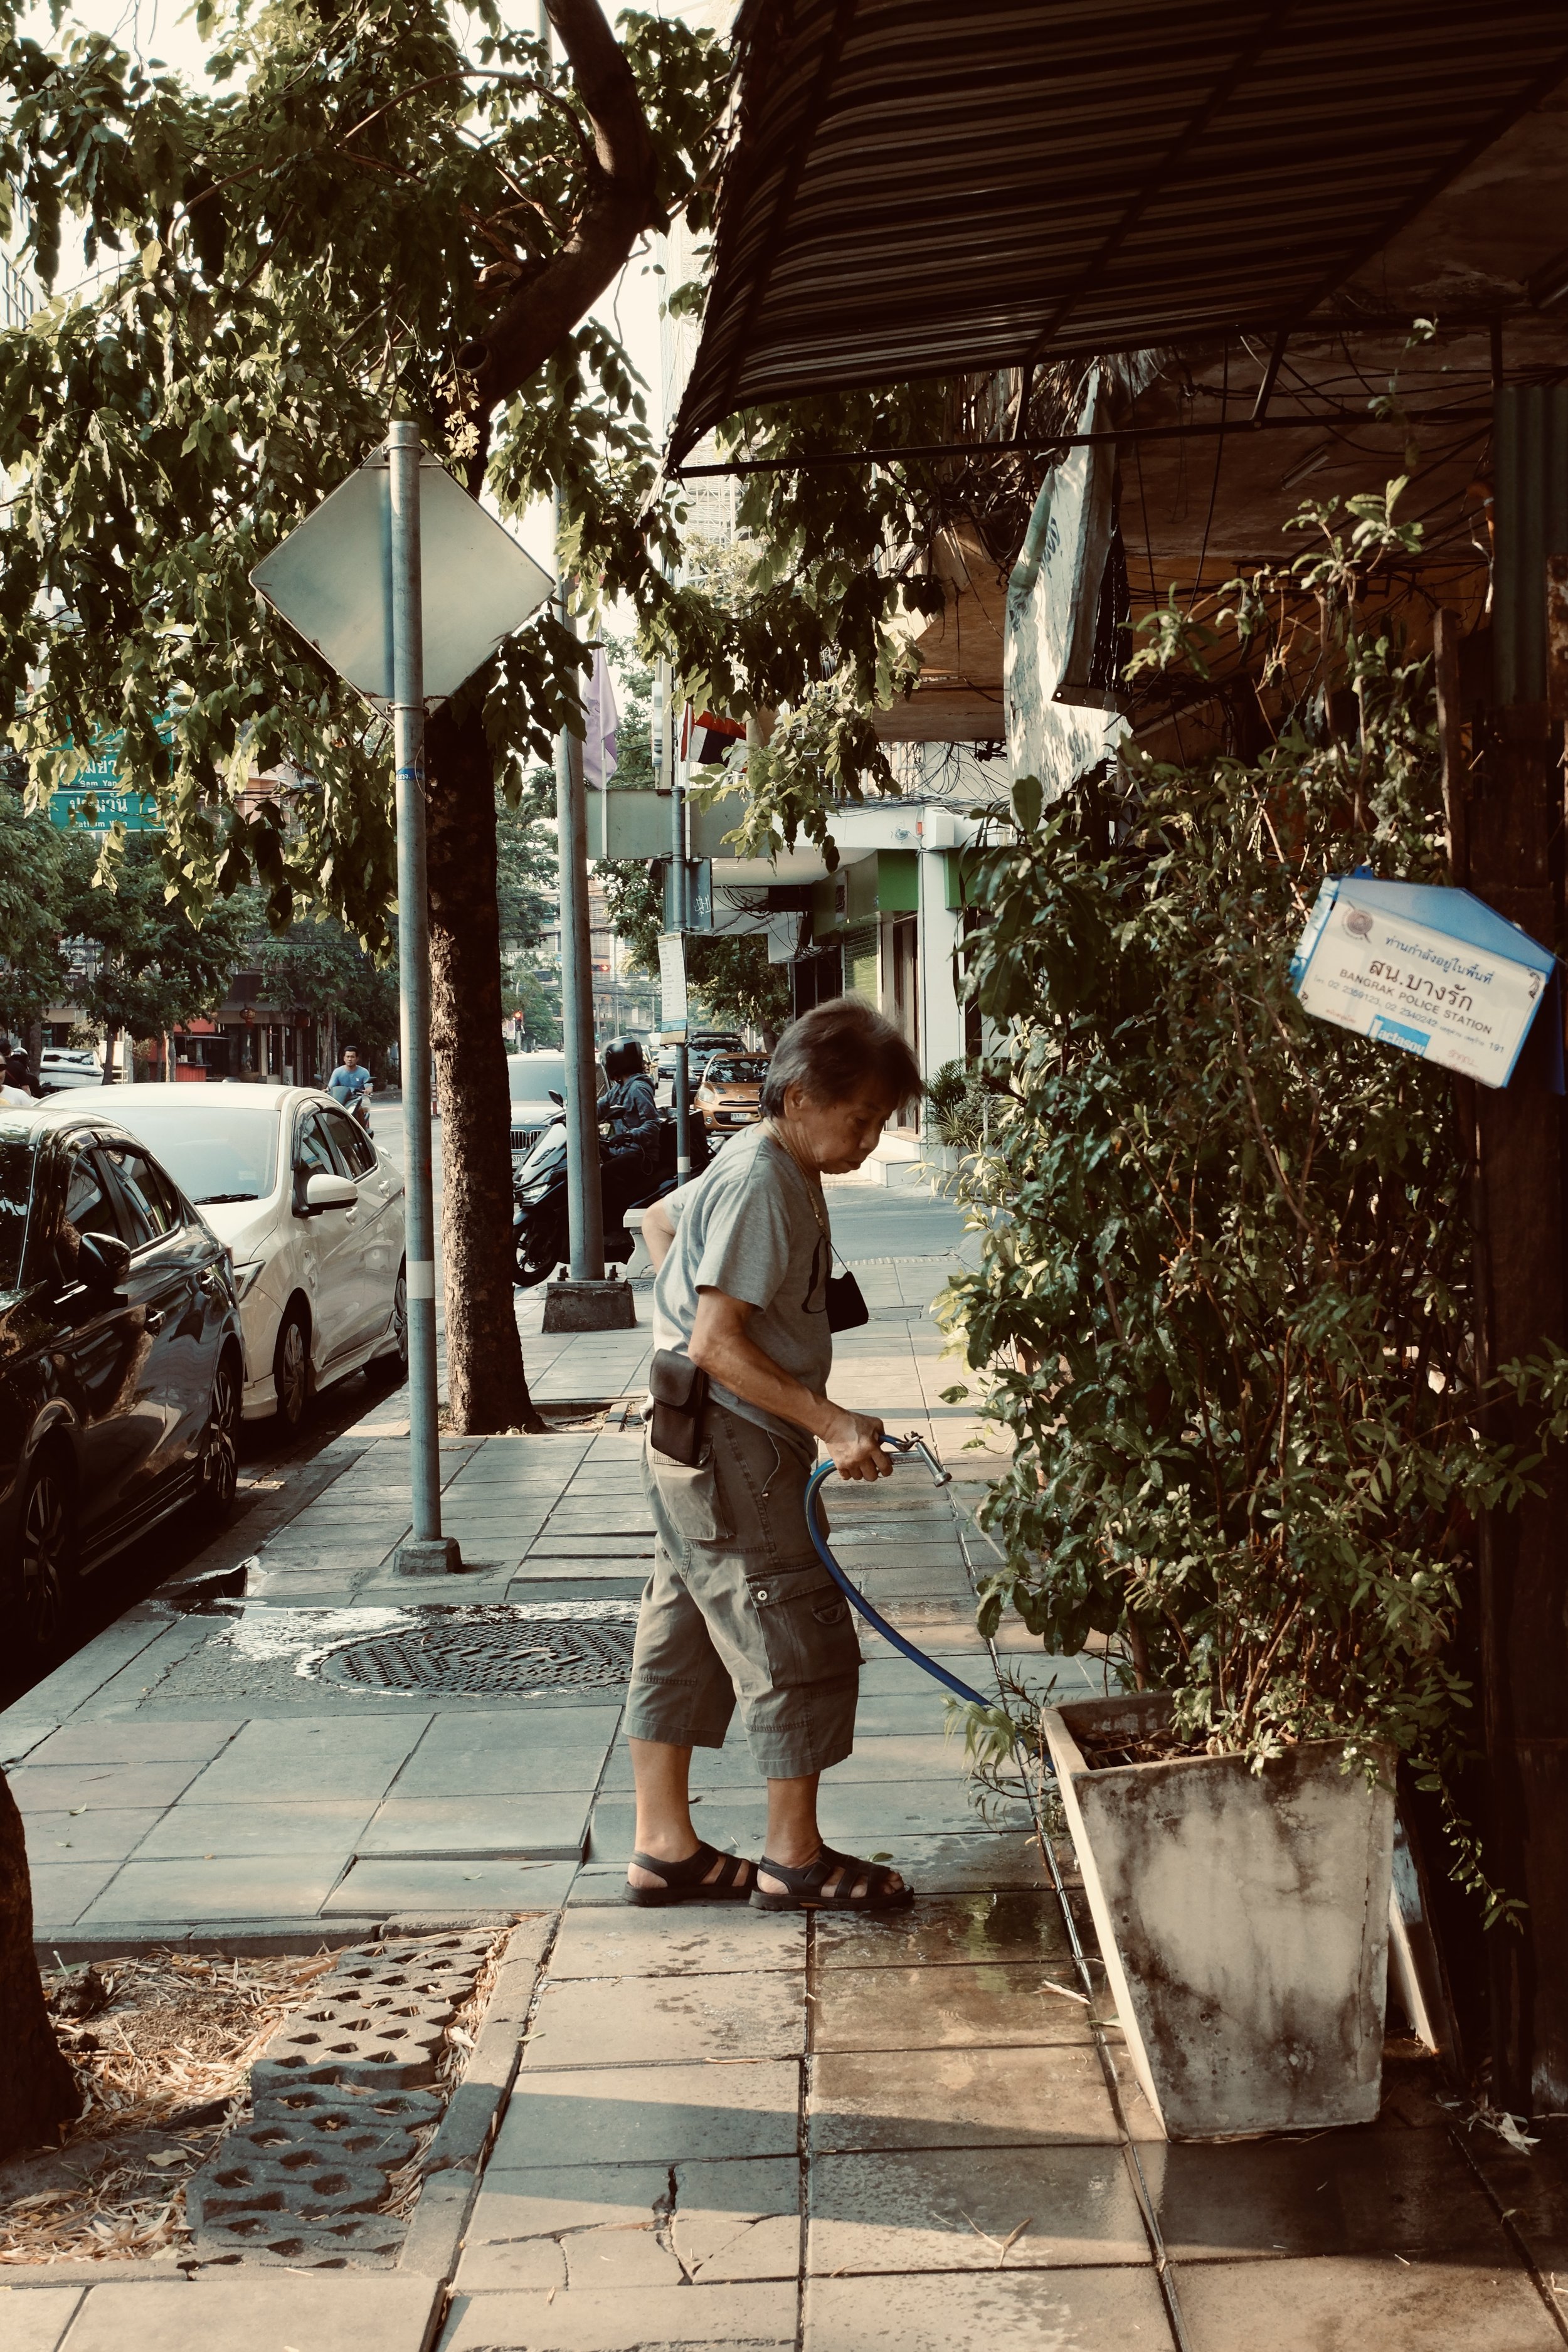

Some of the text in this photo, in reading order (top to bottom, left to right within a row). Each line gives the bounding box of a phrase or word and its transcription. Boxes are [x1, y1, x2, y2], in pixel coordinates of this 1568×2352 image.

[1327, 979, 1340, 990] 02
[1384, 1001, 1397, 1012] 02
[1488, 1042, 1505, 1054] 191
[1339, 968, 1493, 1035] BANGRAK POLICE STATION
[1369, 960, 1473, 1012] สน.บางรัก
